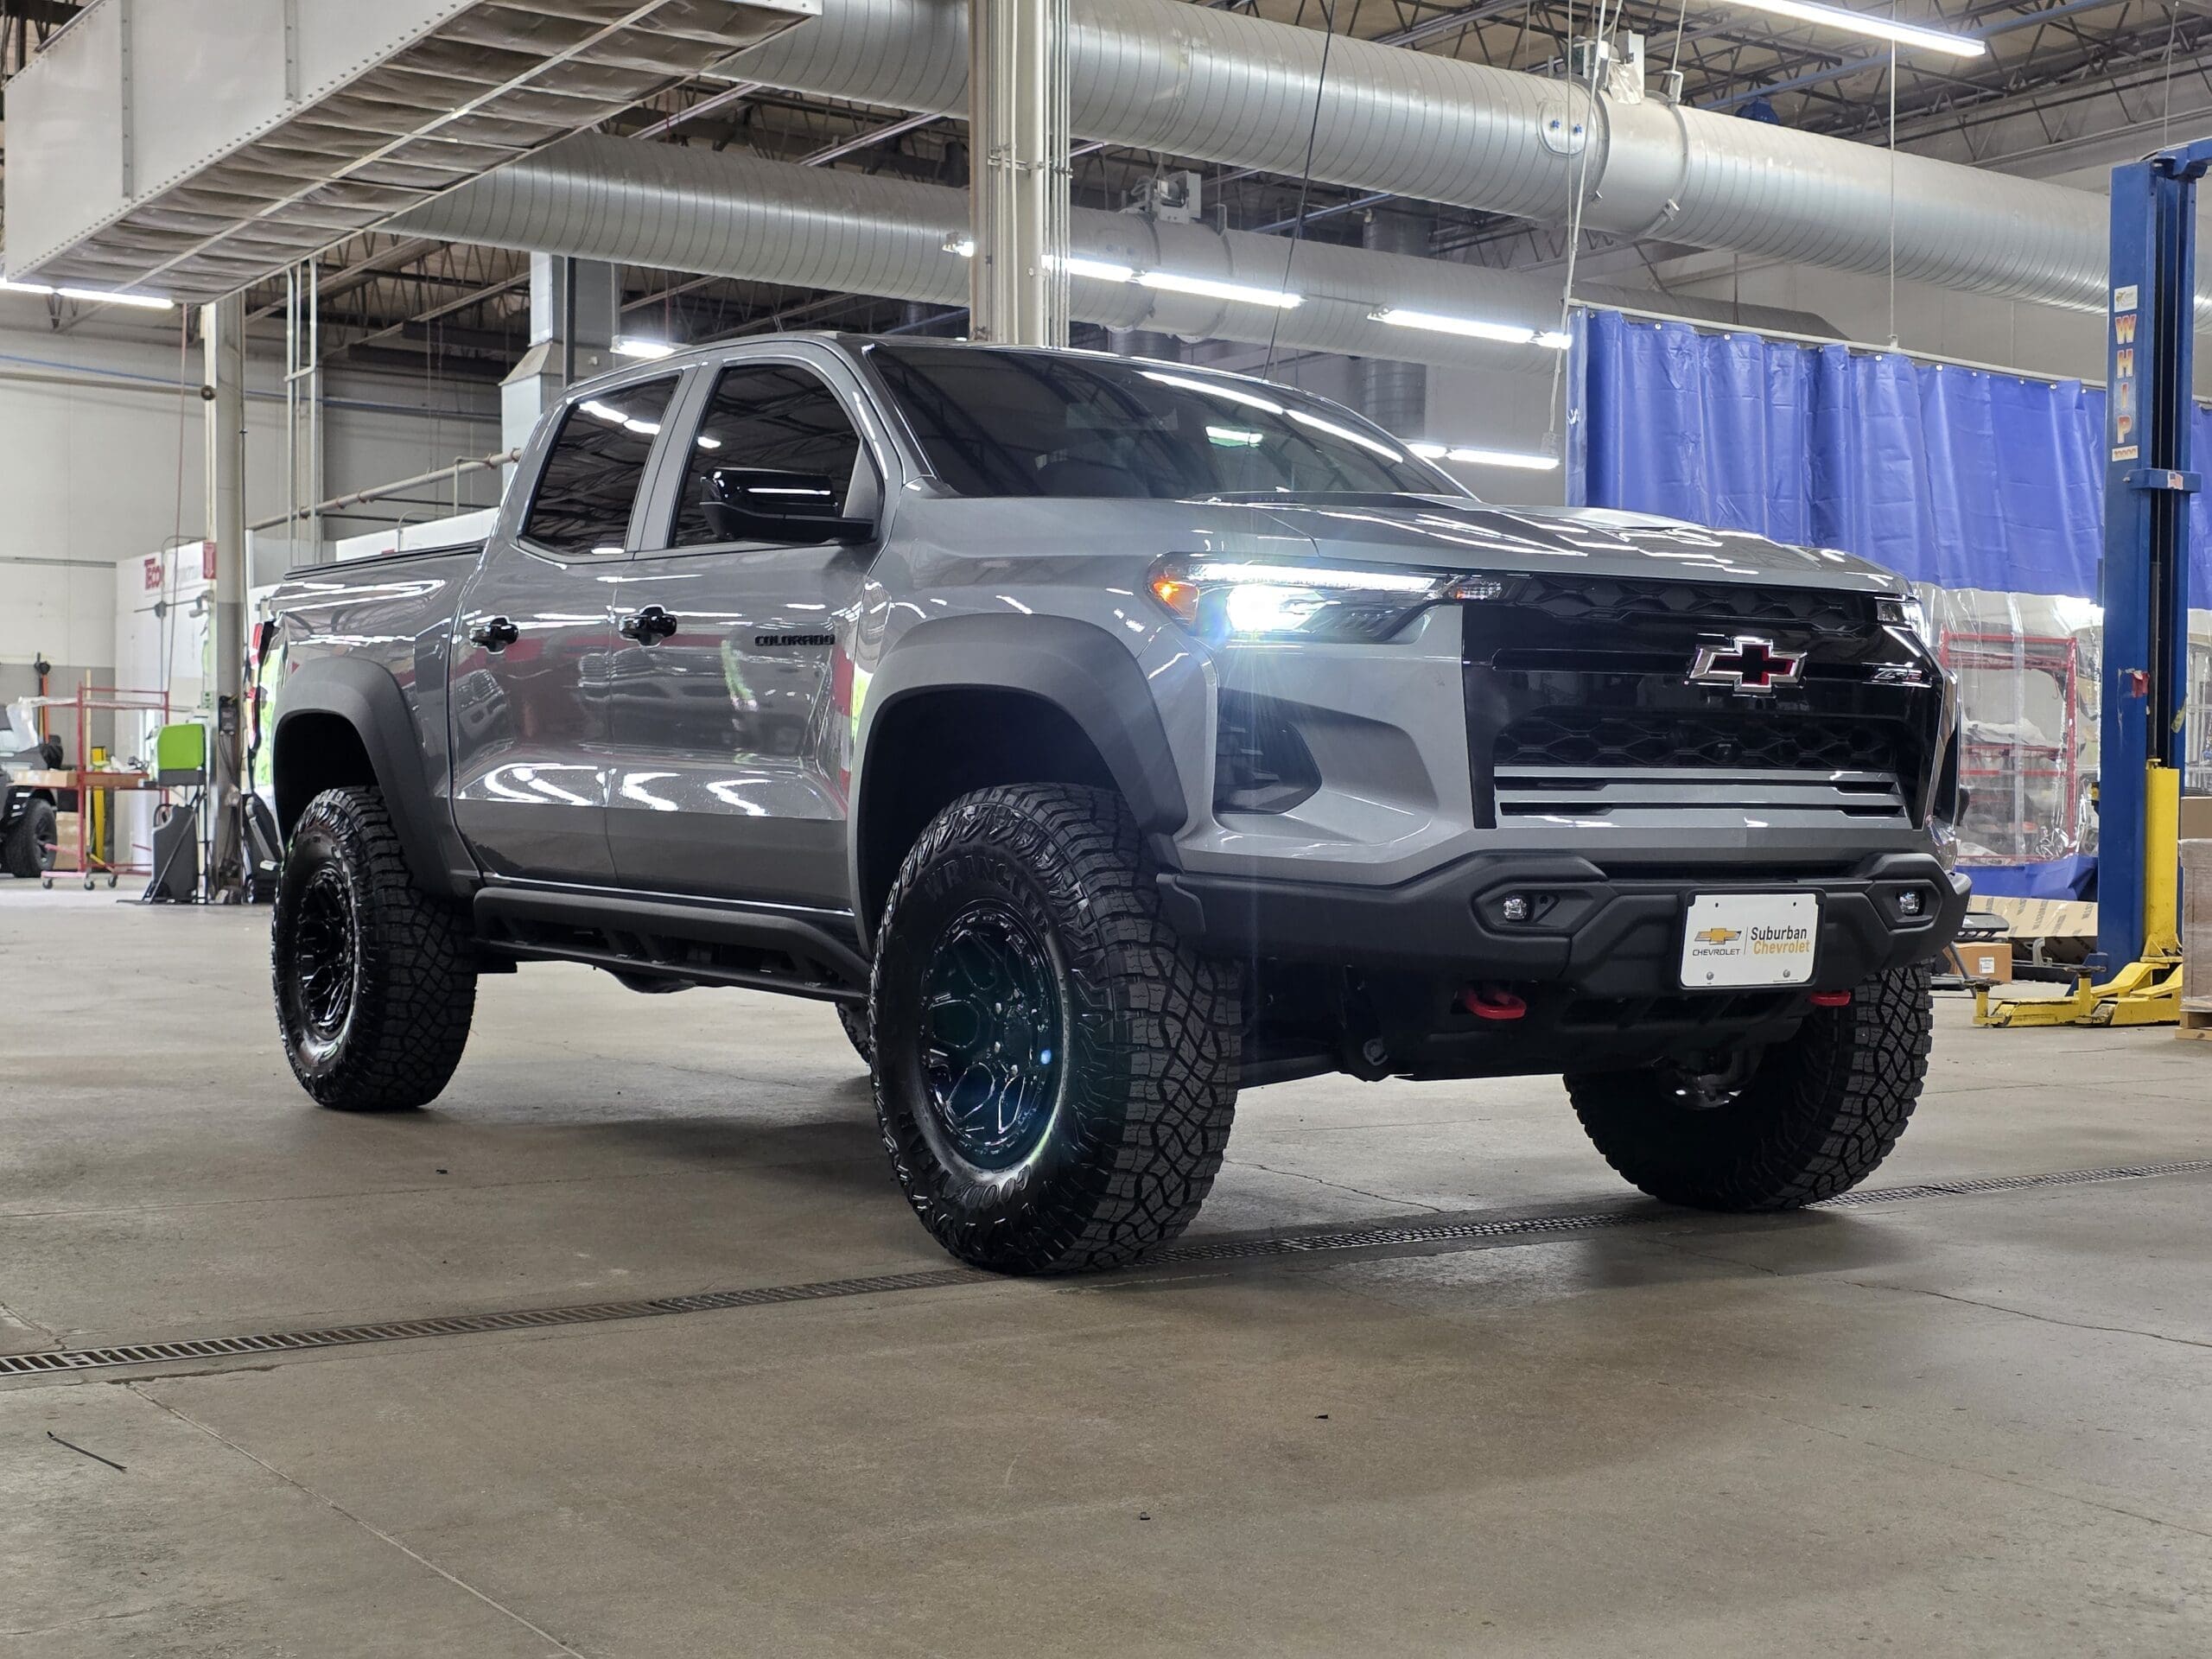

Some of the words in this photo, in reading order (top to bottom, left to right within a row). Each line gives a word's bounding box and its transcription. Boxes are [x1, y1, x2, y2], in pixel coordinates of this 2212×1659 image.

[2114, 314, 2137, 444] WHIP
[754, 634, 836, 646] COLORADO
[1751, 925, 1808, 941] Suburban
[1692, 948, 1741, 957] CHEVROLET
[1753, 939, 1811, 955] Chevrolet
